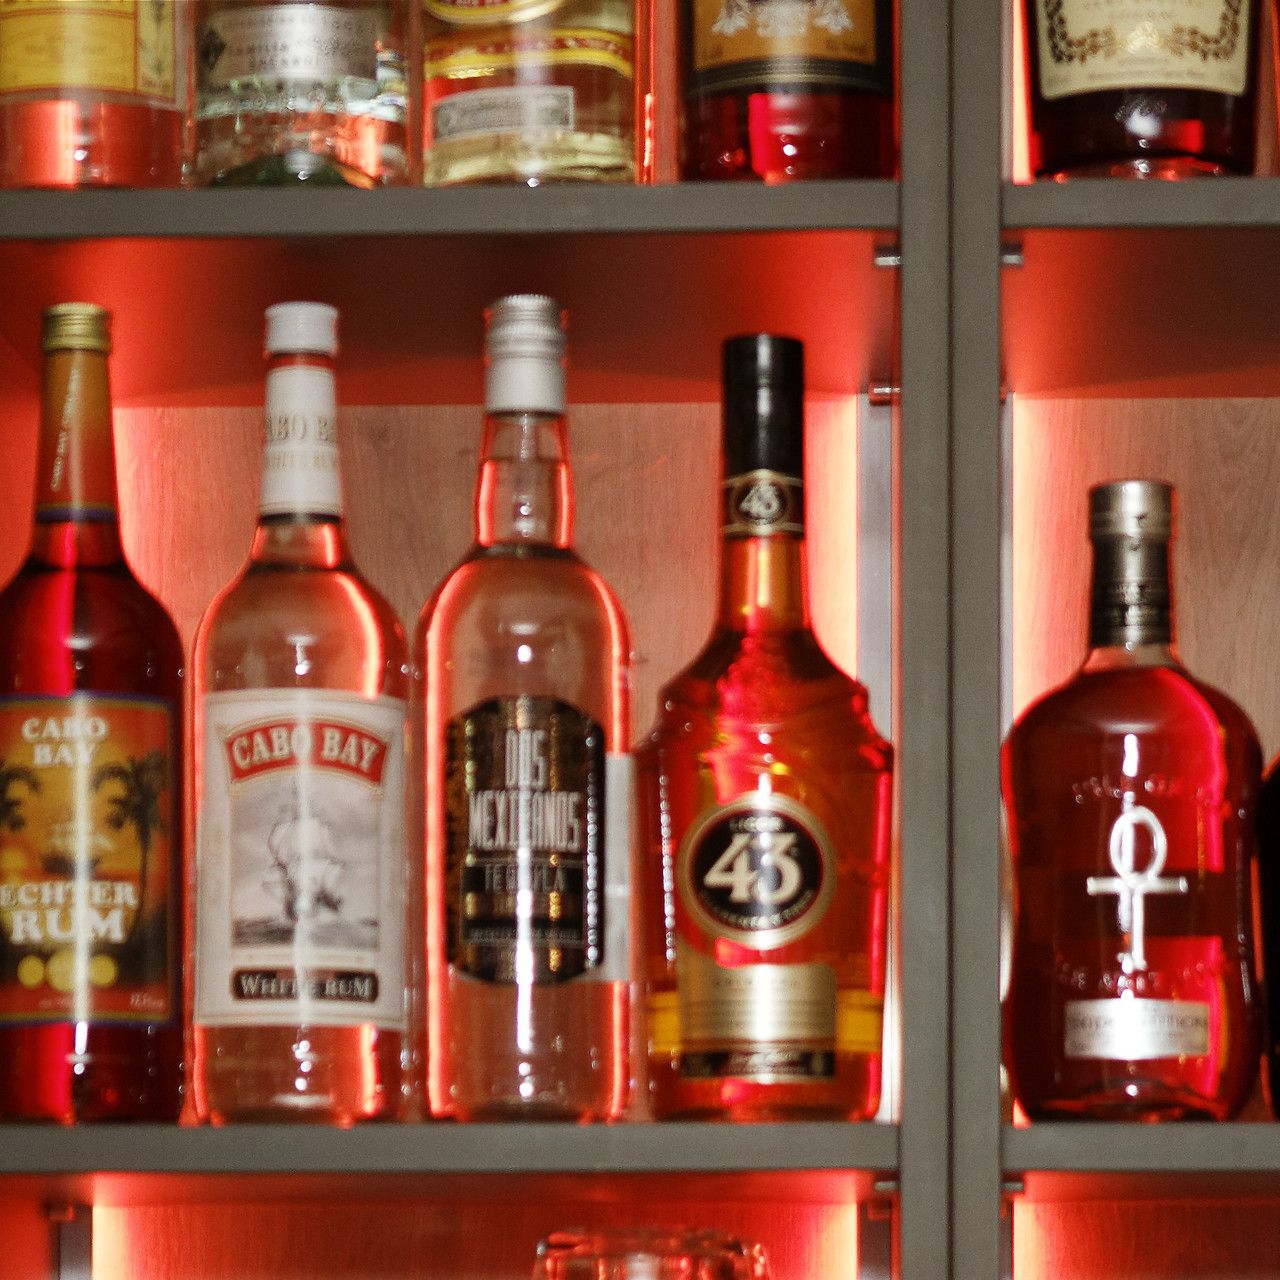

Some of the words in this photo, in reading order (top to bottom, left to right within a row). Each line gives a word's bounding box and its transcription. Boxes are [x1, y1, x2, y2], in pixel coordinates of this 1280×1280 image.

[740, 480, 780, 518] 43
[21, 716, 109, 742] CABO
[33, 742, 97, 768] BAY
[231, 725, 311, 769] CABO
[322, 726, 380, 772] BAY
[504, 728, 549, 791] DOS
[484, 864, 568, 892] TEQILA
[703, 832, 803, 904] 43
[10, 908, 127, 945] RUM
[324, 976, 372, 998] RUM
